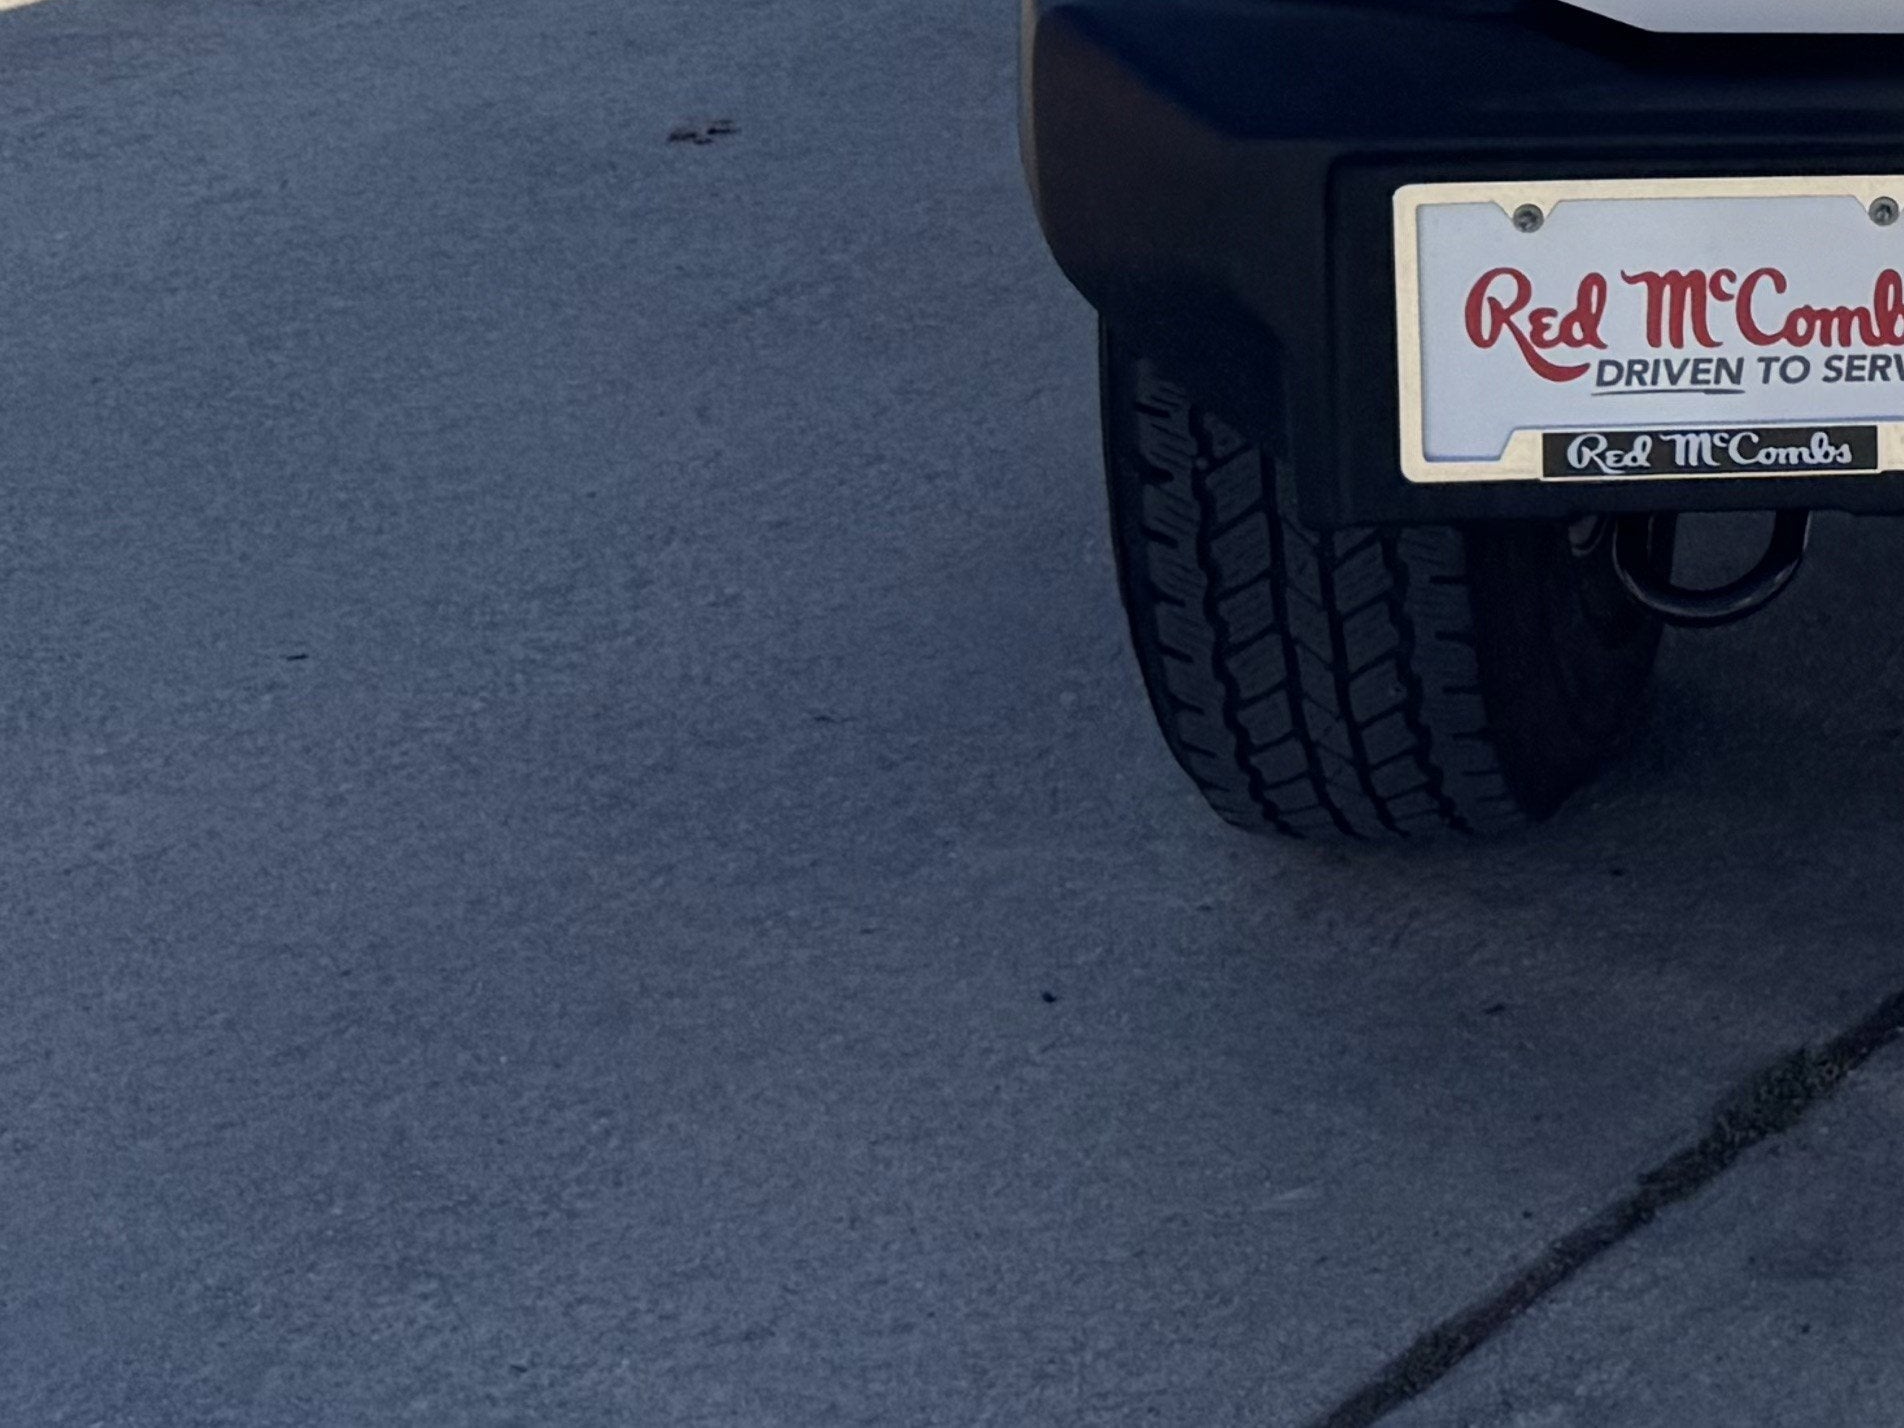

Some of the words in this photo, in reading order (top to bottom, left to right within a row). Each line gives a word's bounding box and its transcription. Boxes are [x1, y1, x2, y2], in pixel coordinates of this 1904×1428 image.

[1465, 267, 1607, 382] Red
[1595, 357, 1745, 387] DRIVEN
[1757, 356, 1811, 385] TO
[1567, 433, 1650, 475] Red
[1660, 432, 1853, 467] McCombs
